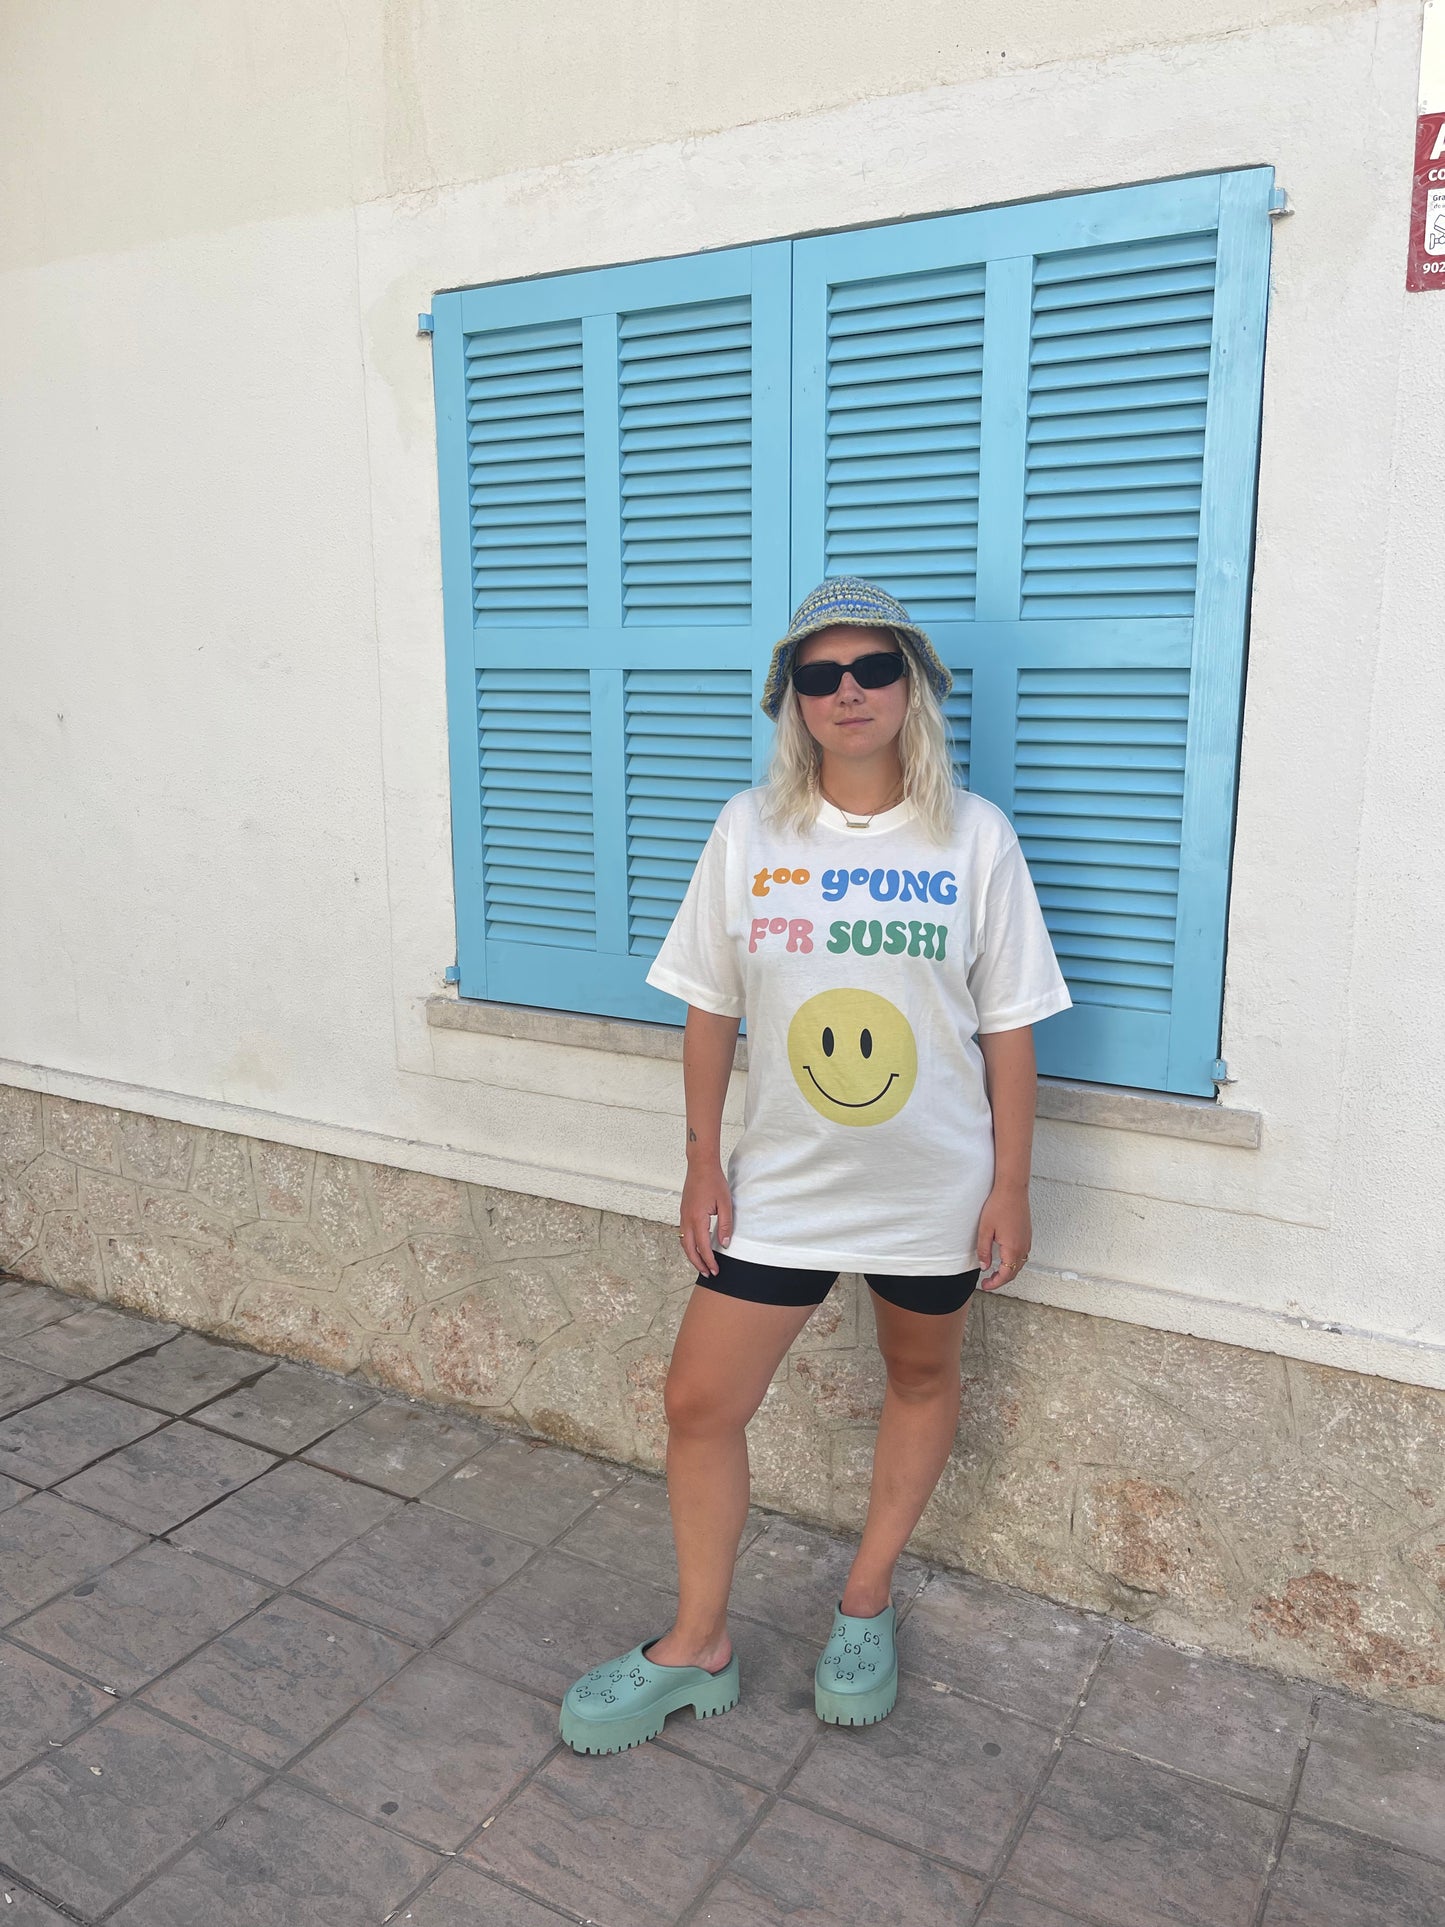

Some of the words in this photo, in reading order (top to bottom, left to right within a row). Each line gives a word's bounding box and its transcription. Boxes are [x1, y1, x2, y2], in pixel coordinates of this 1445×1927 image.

[1423, 262, 1445, 274] 902
[752, 867, 810, 897] too
[826, 919, 948, 962] SUSHI
